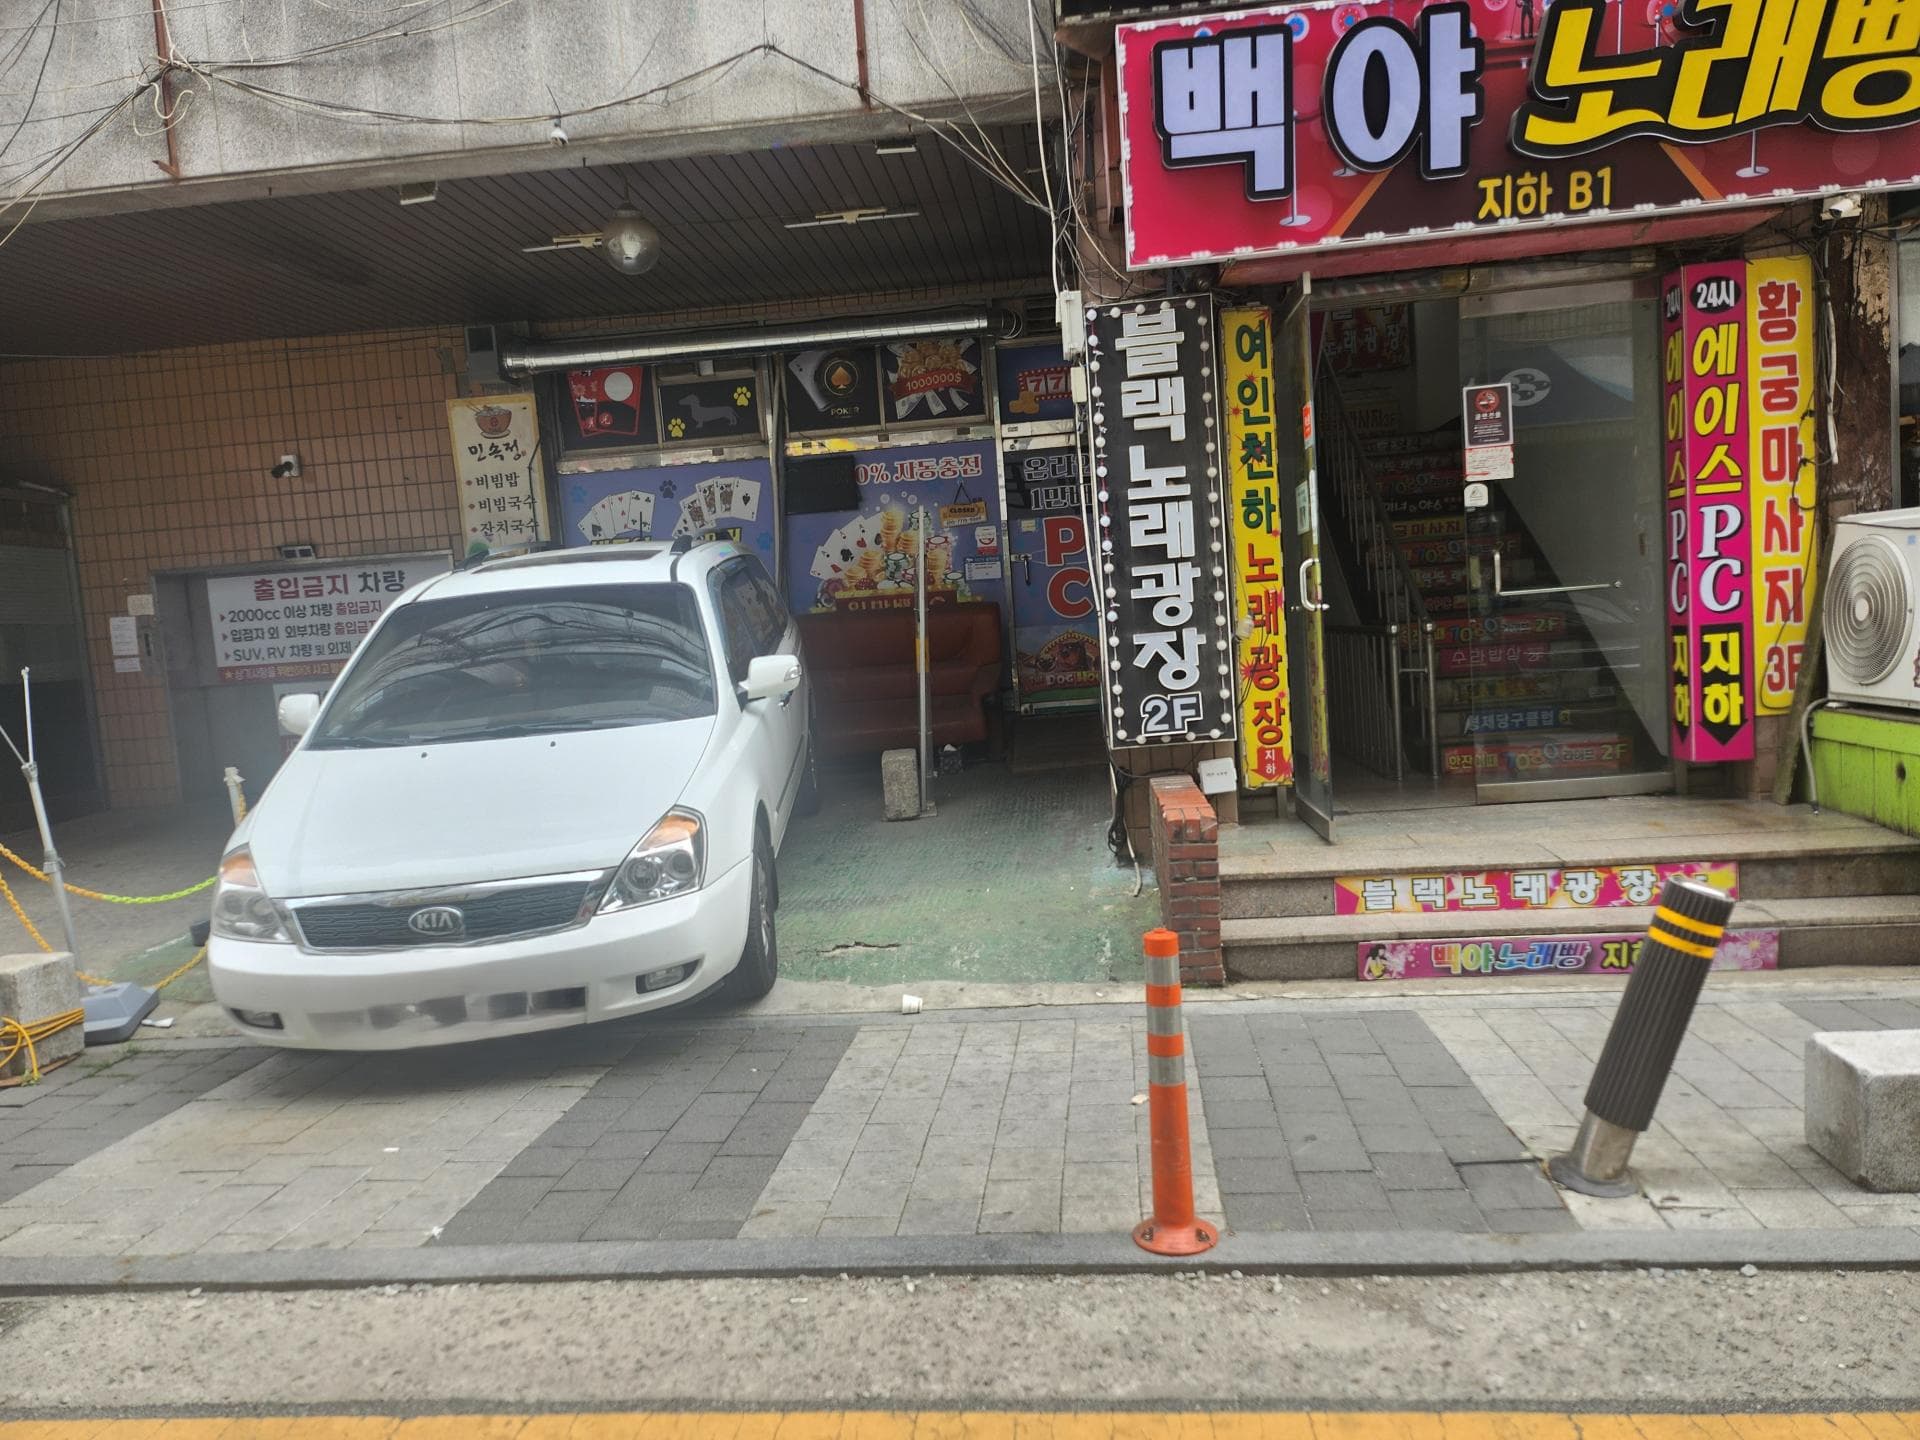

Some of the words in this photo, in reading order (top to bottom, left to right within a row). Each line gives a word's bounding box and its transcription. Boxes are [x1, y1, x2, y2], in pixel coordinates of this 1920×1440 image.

[1161, 11, 1477, 193] 백야
[1477, 171, 1553, 219] 지하
[1569, 166, 1613, 210] B1
[1696, 279, 1736, 308] 24시
[905, 371, 962, 392] 1000000$
[468, 439, 521, 462] 민속정
[1758, 280, 1804, 626] 황궁마사지
[476, 471, 521, 490] 비빔밥
[893, 454, 982, 482] 자동충전
[478, 494, 538, 513] 비빔국수
[480, 518, 540, 537] 잔치국수
[254, 574, 349, 601] 출입금지
[358, 570, 406, 594] 차량
[228, 608, 281, 623] 2000cc
[284, 606, 307, 620] 이상
[311, 603, 333, 617] 차량
[336, 600, 383, 615] 출입금지
[231, 626, 265, 642] 입점자
[268, 625, 280, 639] 외
[285, 623, 331, 638] 외부차량
[268, 646, 286, 659] RV
[290, 643, 312, 657] 차량
[315, 645, 326, 656] 및
[328, 641, 351, 655] 외제
[1672, 633, 1690, 727] 지하
[1700, 631, 1744, 727] 지하
[1767, 645, 1801, 693] 3F
[1140, 693, 1201, 735] 2F
[1264, 748, 1278, 776] 지하
[1600, 743, 1629, 760] 2F
[416, 911, 454, 929] KIA
